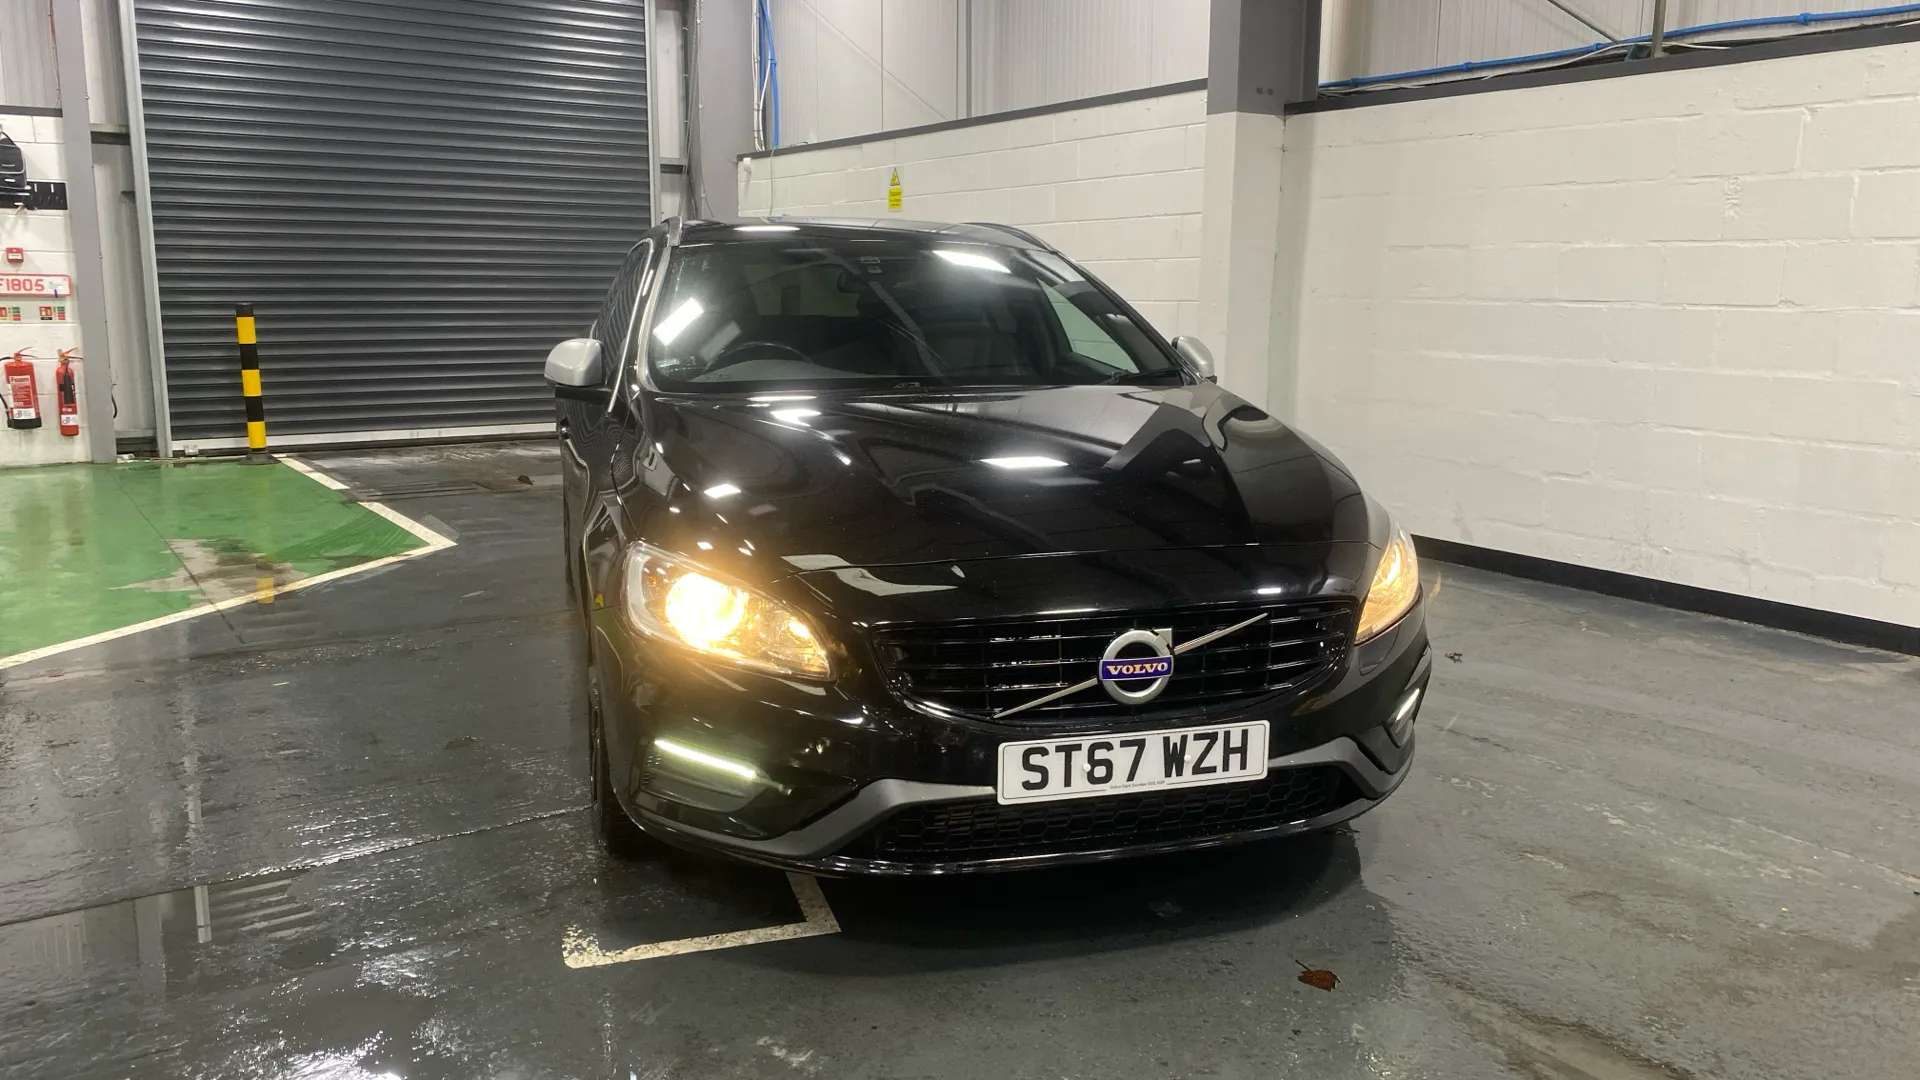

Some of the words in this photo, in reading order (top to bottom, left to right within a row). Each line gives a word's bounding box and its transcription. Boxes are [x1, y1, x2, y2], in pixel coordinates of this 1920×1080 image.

[1106, 662, 1168, 675] VOLVO
[1021, 738, 1147, 791] ST67
[1163, 728, 1249, 778] WZH
